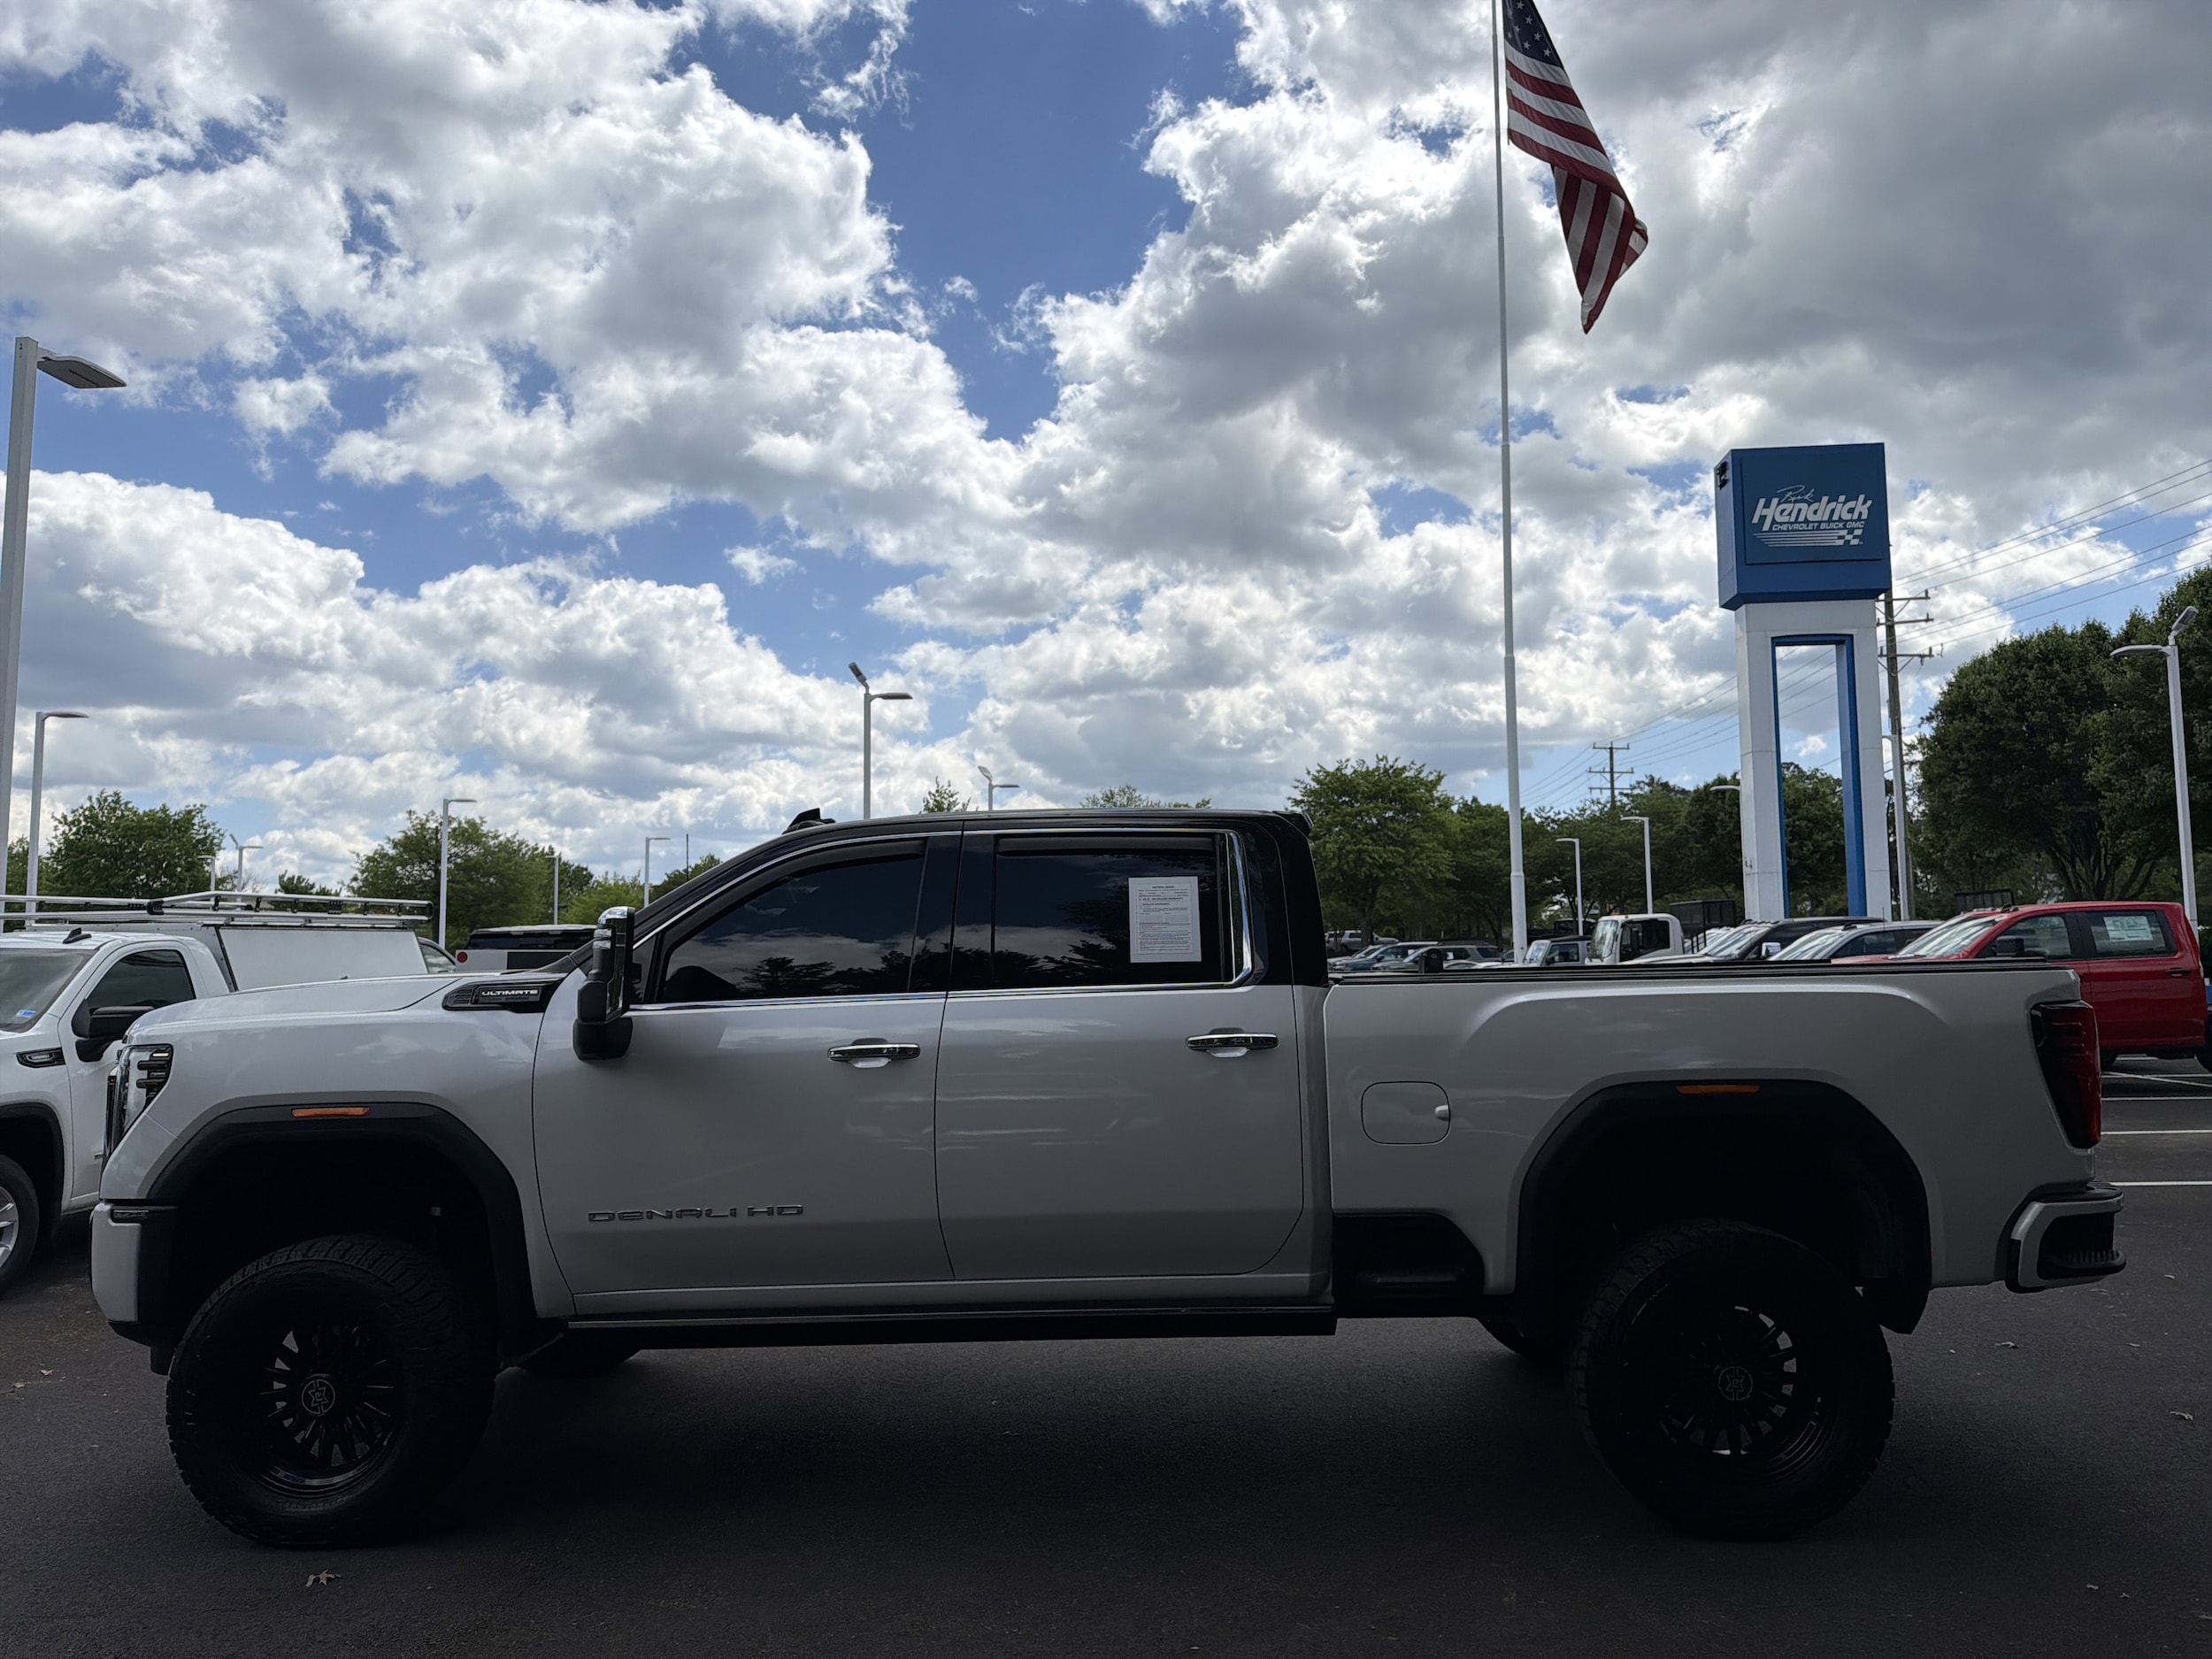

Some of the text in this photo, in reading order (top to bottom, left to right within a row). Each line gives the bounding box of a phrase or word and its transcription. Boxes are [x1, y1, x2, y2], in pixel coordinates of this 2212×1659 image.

[1752, 495, 1872, 531] Hendrick
[1772, 522, 1819, 531] CHEVROLET
[588, 1204, 804, 1223] DENALI HD
